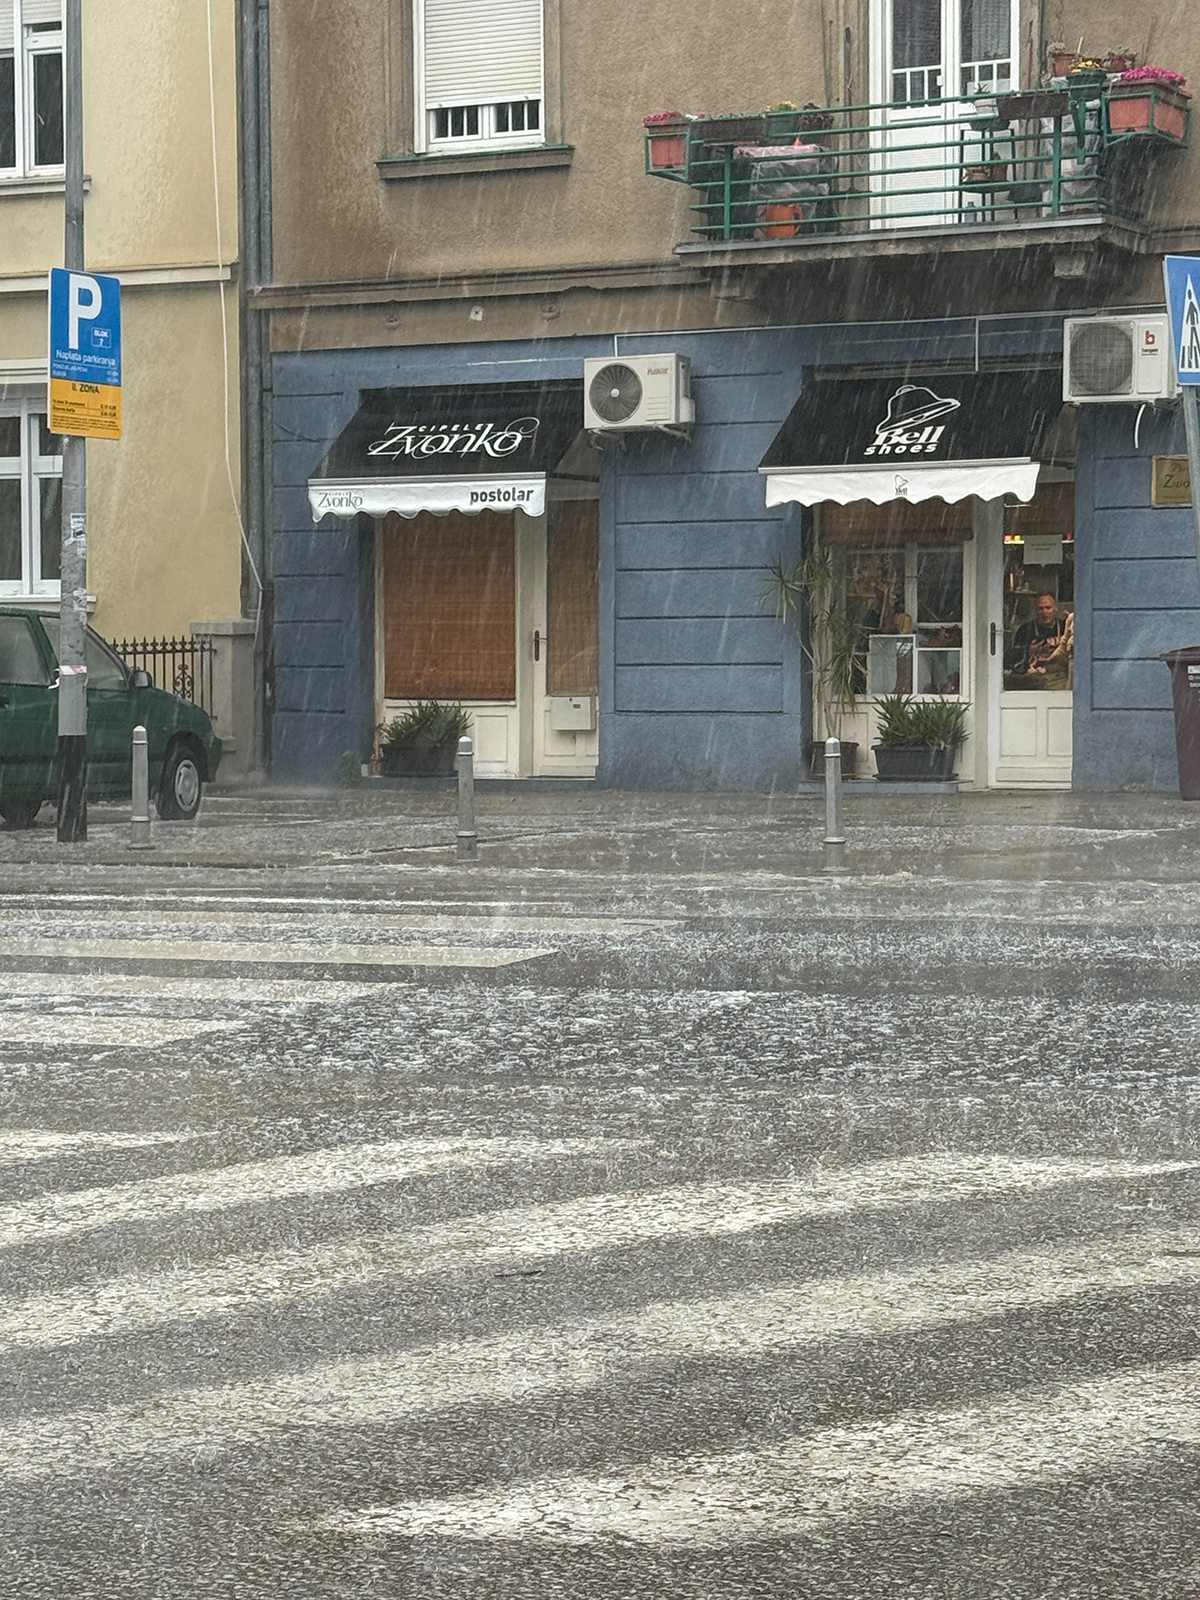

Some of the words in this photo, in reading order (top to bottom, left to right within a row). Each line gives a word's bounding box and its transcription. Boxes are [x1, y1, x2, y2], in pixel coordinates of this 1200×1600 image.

[69, 273, 102, 350] P
[99, 338, 105, 346] 7
[56, 349, 82, 362] Naplata
[82, 354, 116, 369] parkiranja
[79, 384, 100, 394] ZONA
[418, 423, 485, 433] CIPELE
[872, 424, 946, 446] Bell
[367, 417, 540, 461] Zvonko
[863, 443, 938, 456] shoes
[317, 490, 365, 510] Zvonko
[469, 486, 535, 506] postolar
